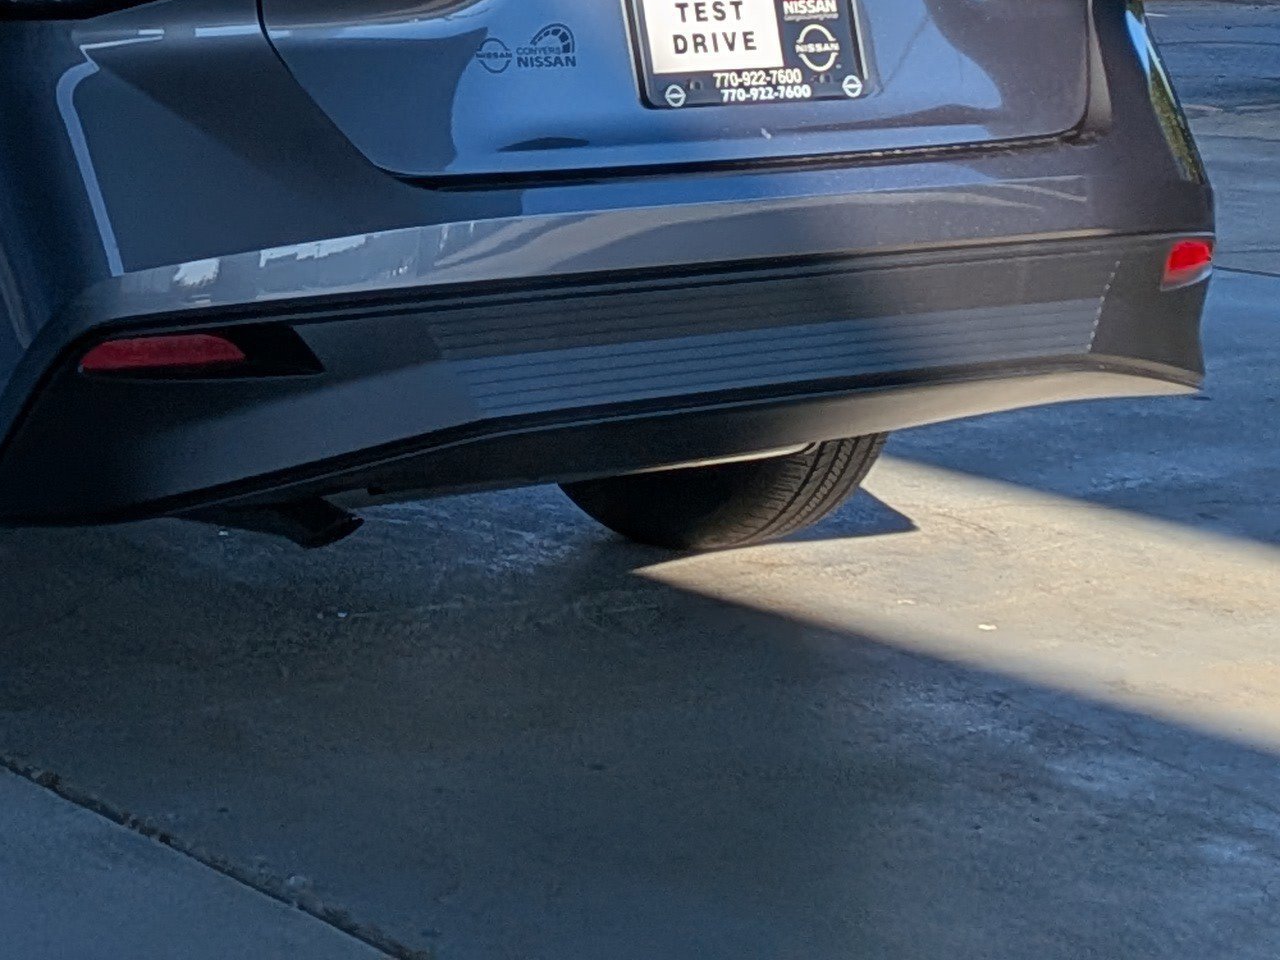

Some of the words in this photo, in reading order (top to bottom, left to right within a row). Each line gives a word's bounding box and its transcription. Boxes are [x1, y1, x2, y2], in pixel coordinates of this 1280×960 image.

[675, 1, 743, 23] TEST
[672, 31, 757, 55] DRIVE
[795, 42, 840, 53] NISSAN
[516, 55, 577, 68] NISSAN
[713, 68, 803, 89] 770-922-7600
